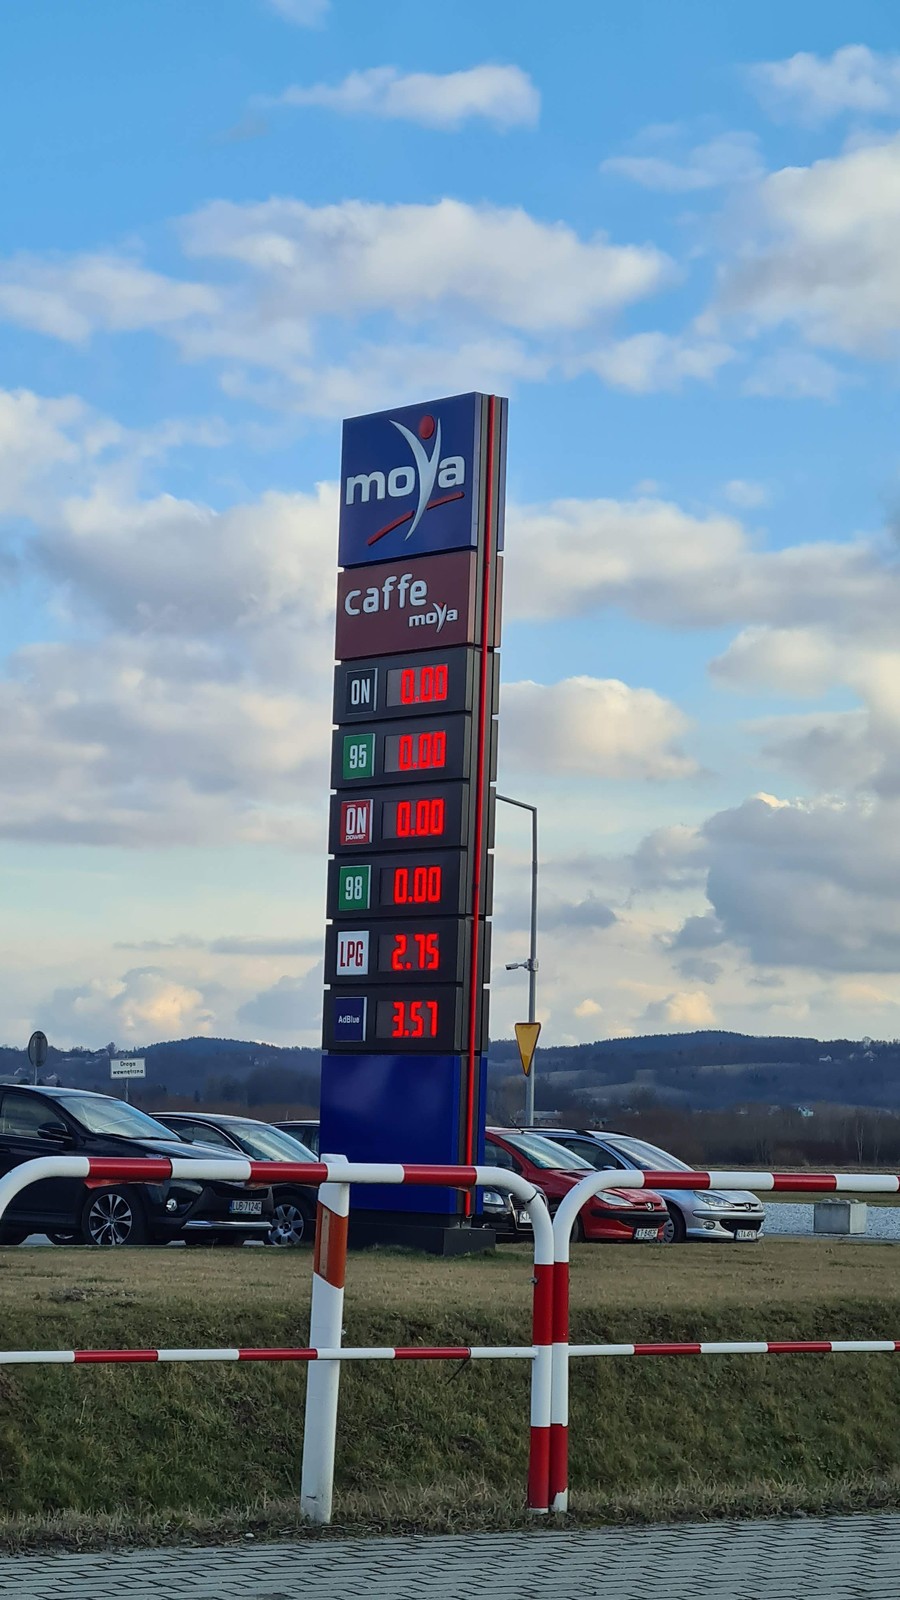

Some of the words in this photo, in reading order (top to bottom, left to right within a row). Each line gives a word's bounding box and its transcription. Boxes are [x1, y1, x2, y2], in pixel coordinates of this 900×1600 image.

[344, 573, 428, 616] caffe
[351, 678, 371, 706] ON
[402, 665, 448, 704] 0.00
[349, 744, 367, 769] 95
[399, 732, 446, 771] 0.00
[346, 807, 367, 835] ON
[396, 798, 444, 837] 0.00
[345, 834, 366, 842] power
[345, 876, 363, 901] 98
[394, 867, 442, 904] 0.00
[339, 941, 364, 968] LPG
[391, 933, 440, 971] 2.75
[338, 1014, 360, 1024] AdBlue
[392, 1001, 439, 1037] 3.57
